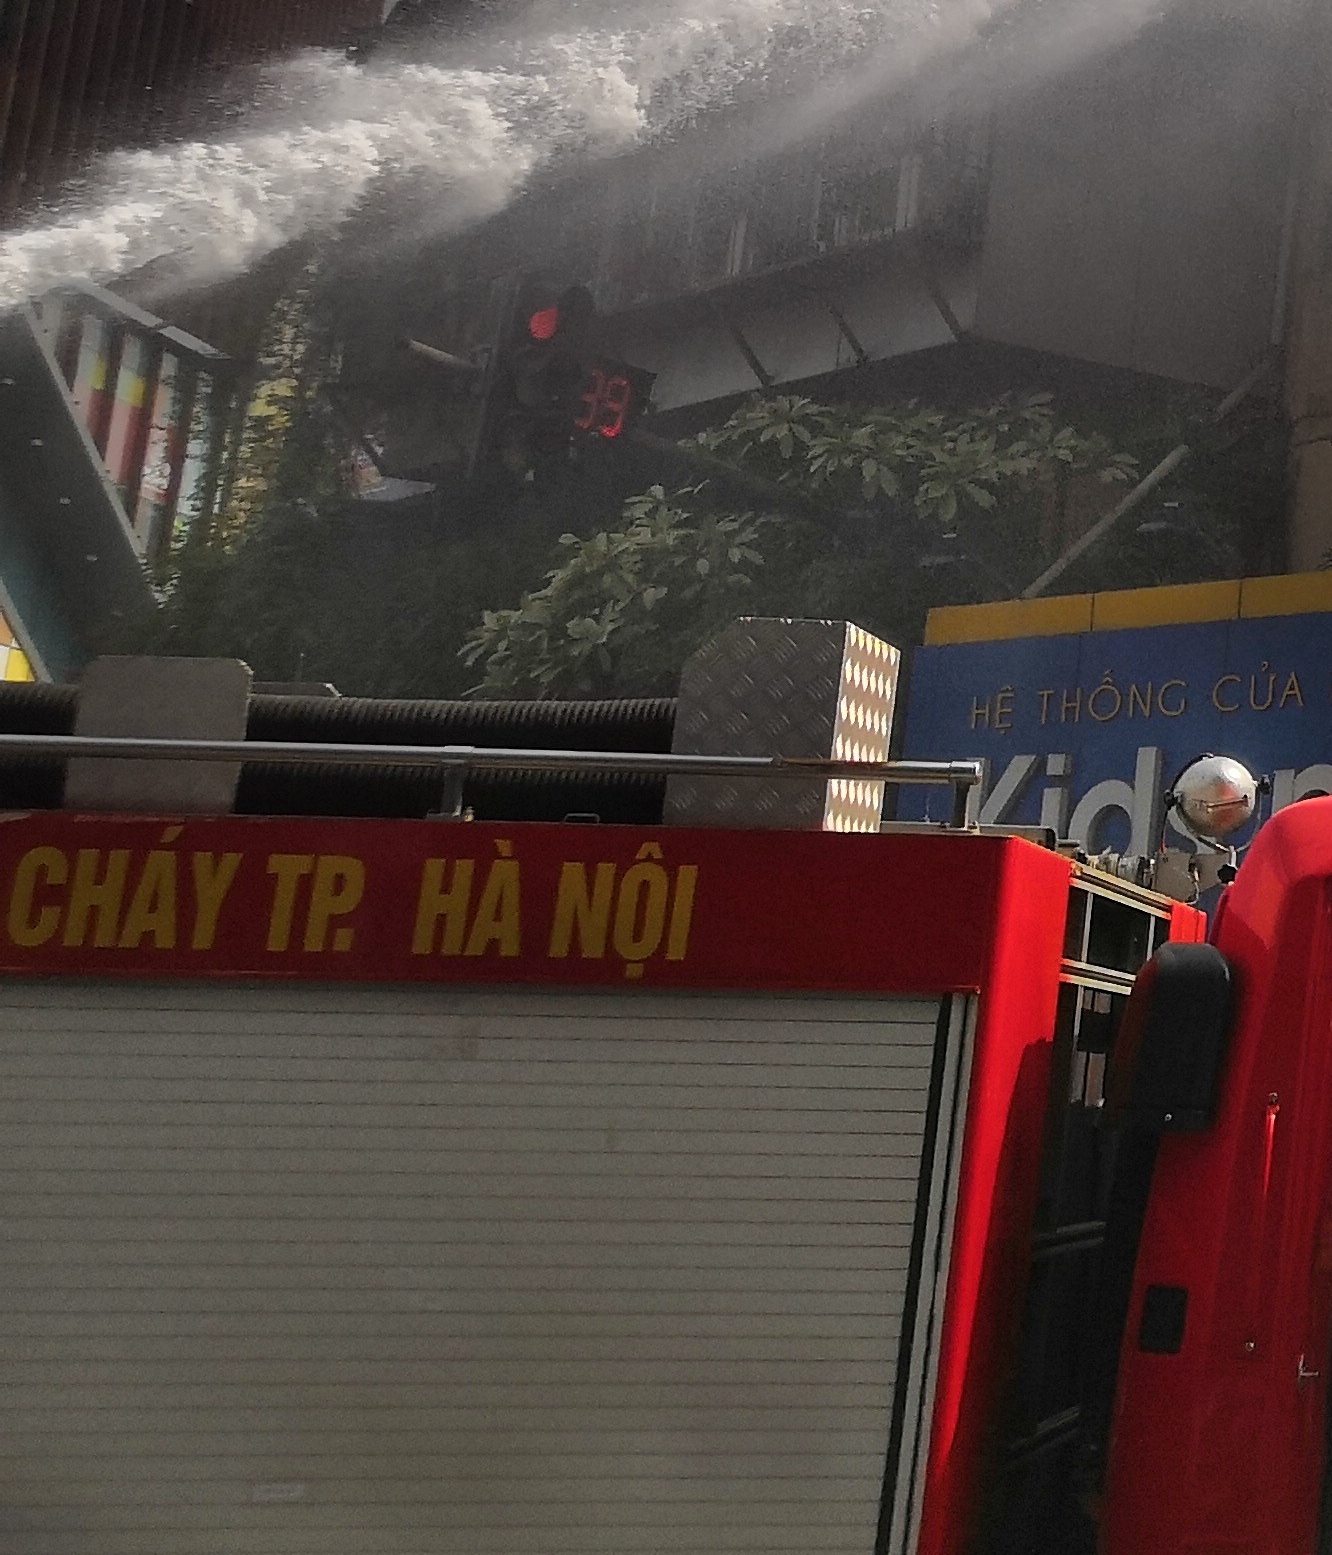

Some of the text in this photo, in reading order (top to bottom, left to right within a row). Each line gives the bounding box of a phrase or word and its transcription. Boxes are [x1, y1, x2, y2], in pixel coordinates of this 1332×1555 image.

[970, 685, 1017, 734] HỆ
[1037, 669, 1189, 724] THỐNG
[1212, 661, 1305, 712] CỬA
[6, 826, 700, 978] CHÁY TP. HÀ NỘI
